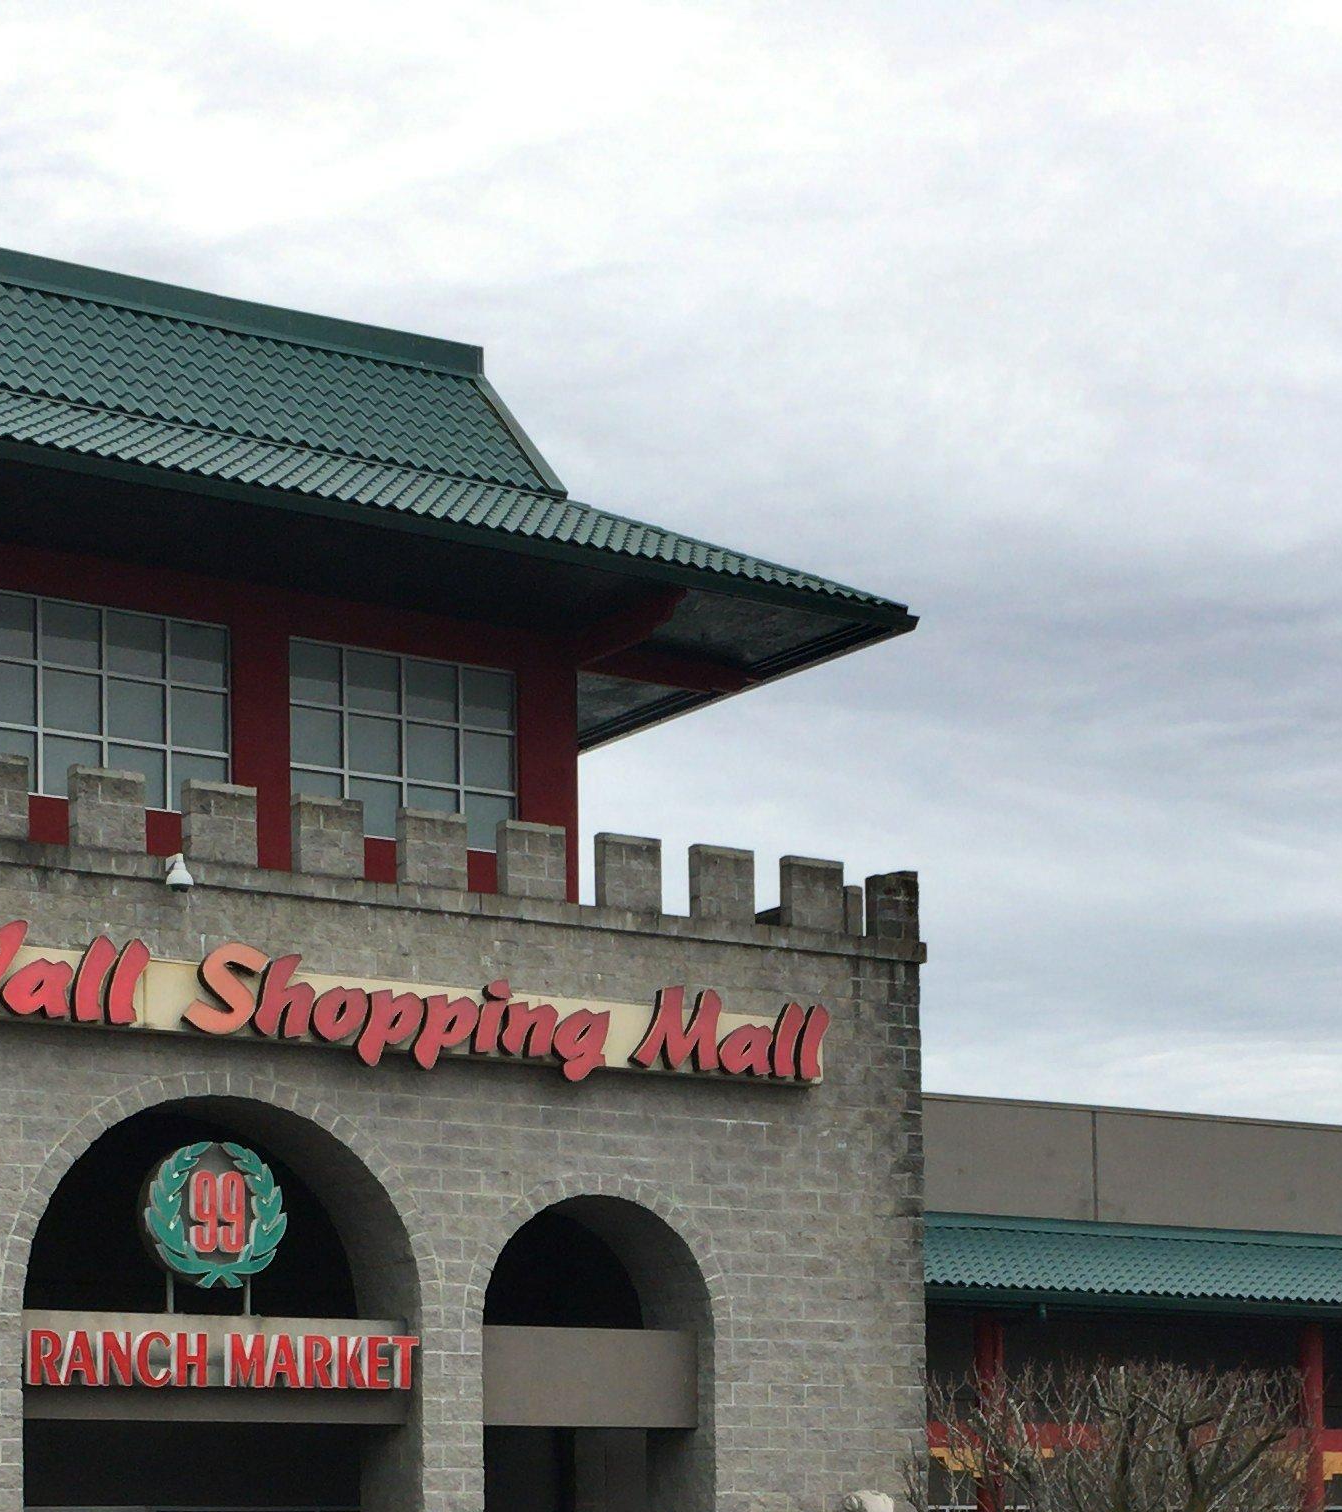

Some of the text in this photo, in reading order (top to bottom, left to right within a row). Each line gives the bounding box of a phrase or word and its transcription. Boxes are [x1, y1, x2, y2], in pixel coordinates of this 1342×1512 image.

[182, 943, 610, 1081] Shopping
[630, 986, 829, 1080] Mall
[190, 1170, 245, 1253] 99
[28, 1329, 419, 1391] RANCH MARKET
